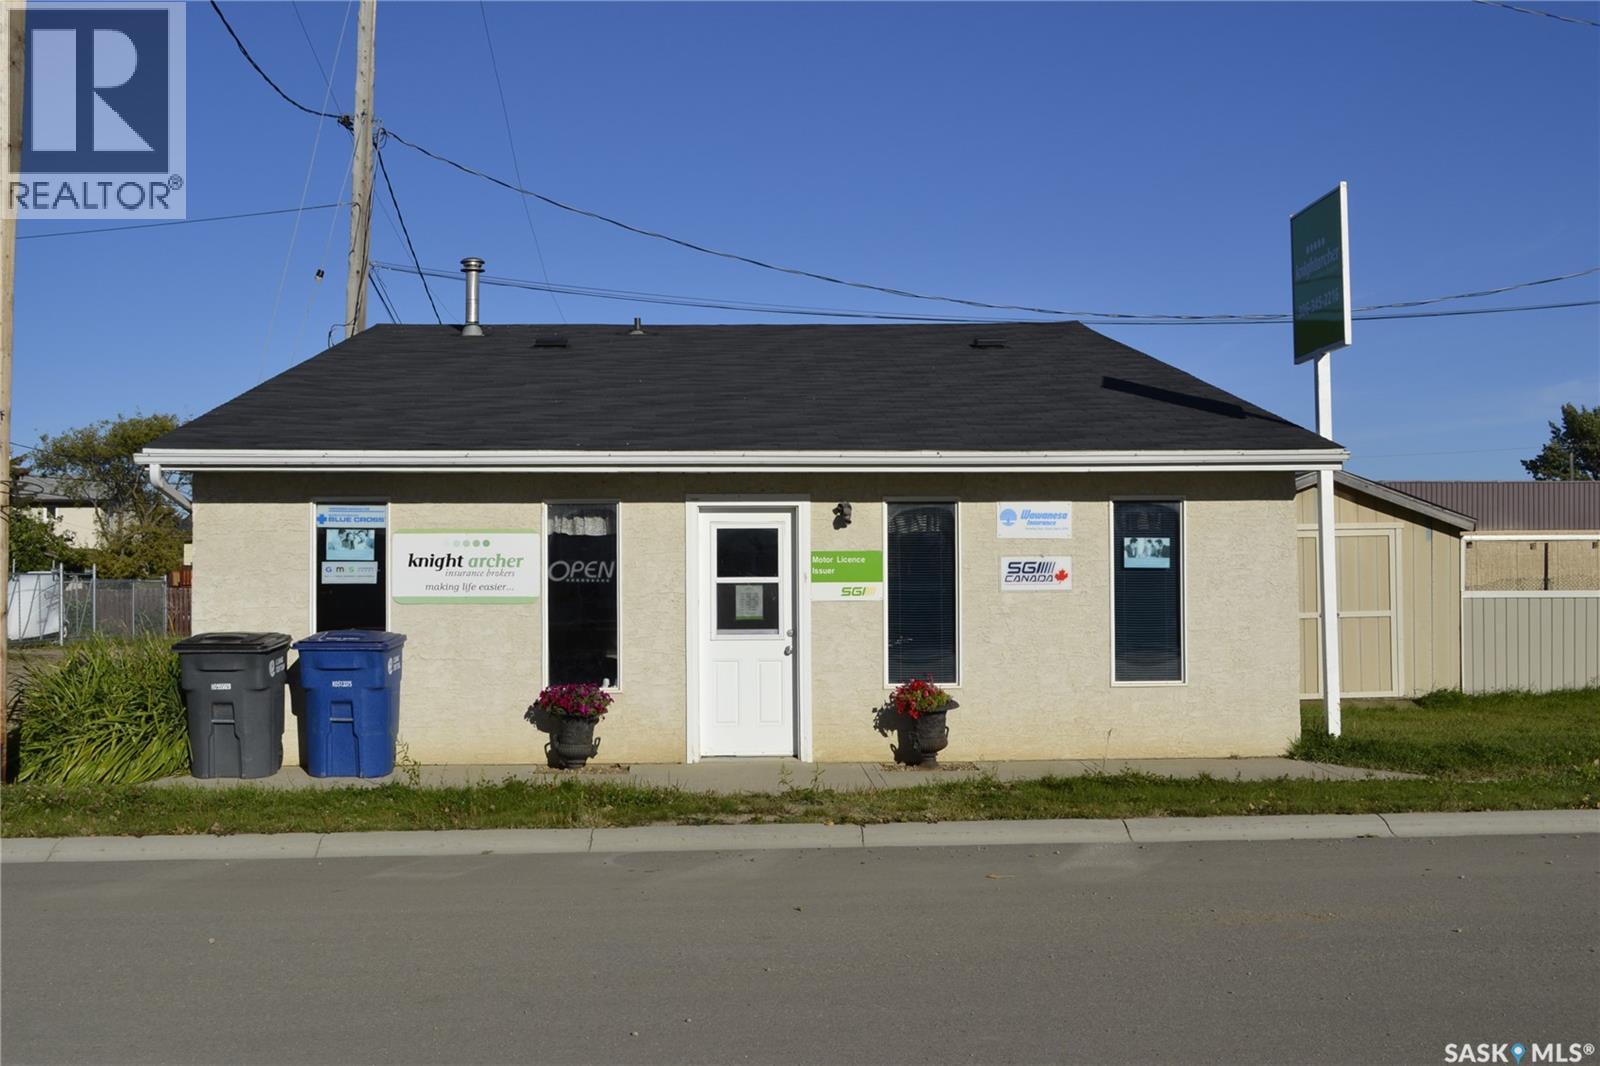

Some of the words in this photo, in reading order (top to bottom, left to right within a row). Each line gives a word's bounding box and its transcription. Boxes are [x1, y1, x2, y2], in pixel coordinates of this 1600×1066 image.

[1021, 509, 1068, 519] Wawanesa
[408, 553, 464, 571] knight
[468, 554, 524, 568] archer
[445, 569, 484, 577] insurance
[486, 568, 515, 577] brokers
[548, 560, 615, 582] OPEN
[1007, 561, 1042, 574] SGI
[1004, 575, 1054, 583] CANADA
[425, 583, 459, 592] making
[462, 582, 477, 593] life
[479, 583, 515, 591] easier...
[841, 587, 867, 597] SGI
